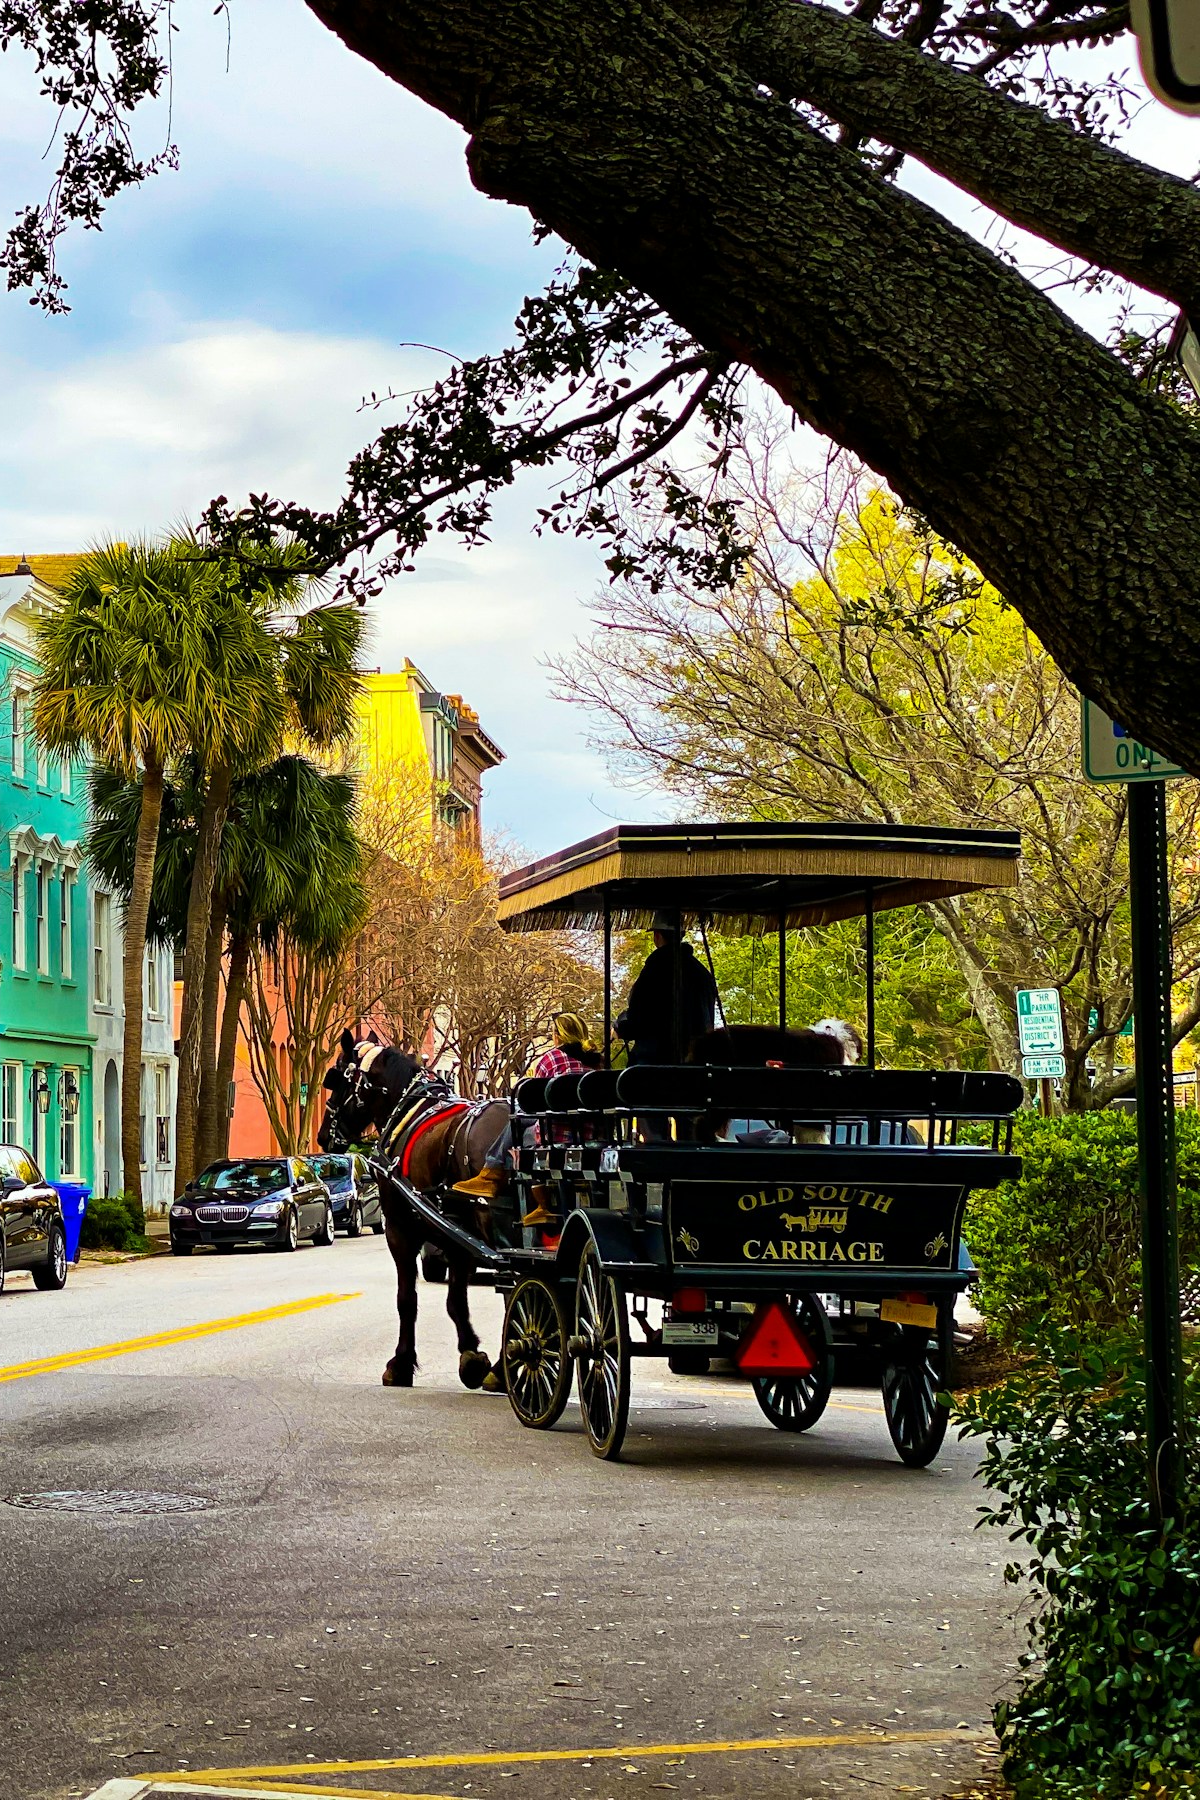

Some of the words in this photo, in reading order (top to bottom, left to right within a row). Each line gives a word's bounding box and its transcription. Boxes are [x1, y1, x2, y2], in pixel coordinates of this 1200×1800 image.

[1116, 742, 1169, 768] ONL
[1022, 996, 1028, 1011] 1
[1039, 993, 1049, 1001] HR
[1031, 1003, 1057, 1012] PARKING
[1024, 1016, 1055, 1024] RESIDENTIAL
[1025, 1032, 1050, 1040] DISTRICT
[738, 1187, 794, 1211] OLD
[802, 1184, 894, 1214] SOUTH
[742, 1239, 886, 1262] CARRIAGE
[692, 1321, 716, 1334] 338
